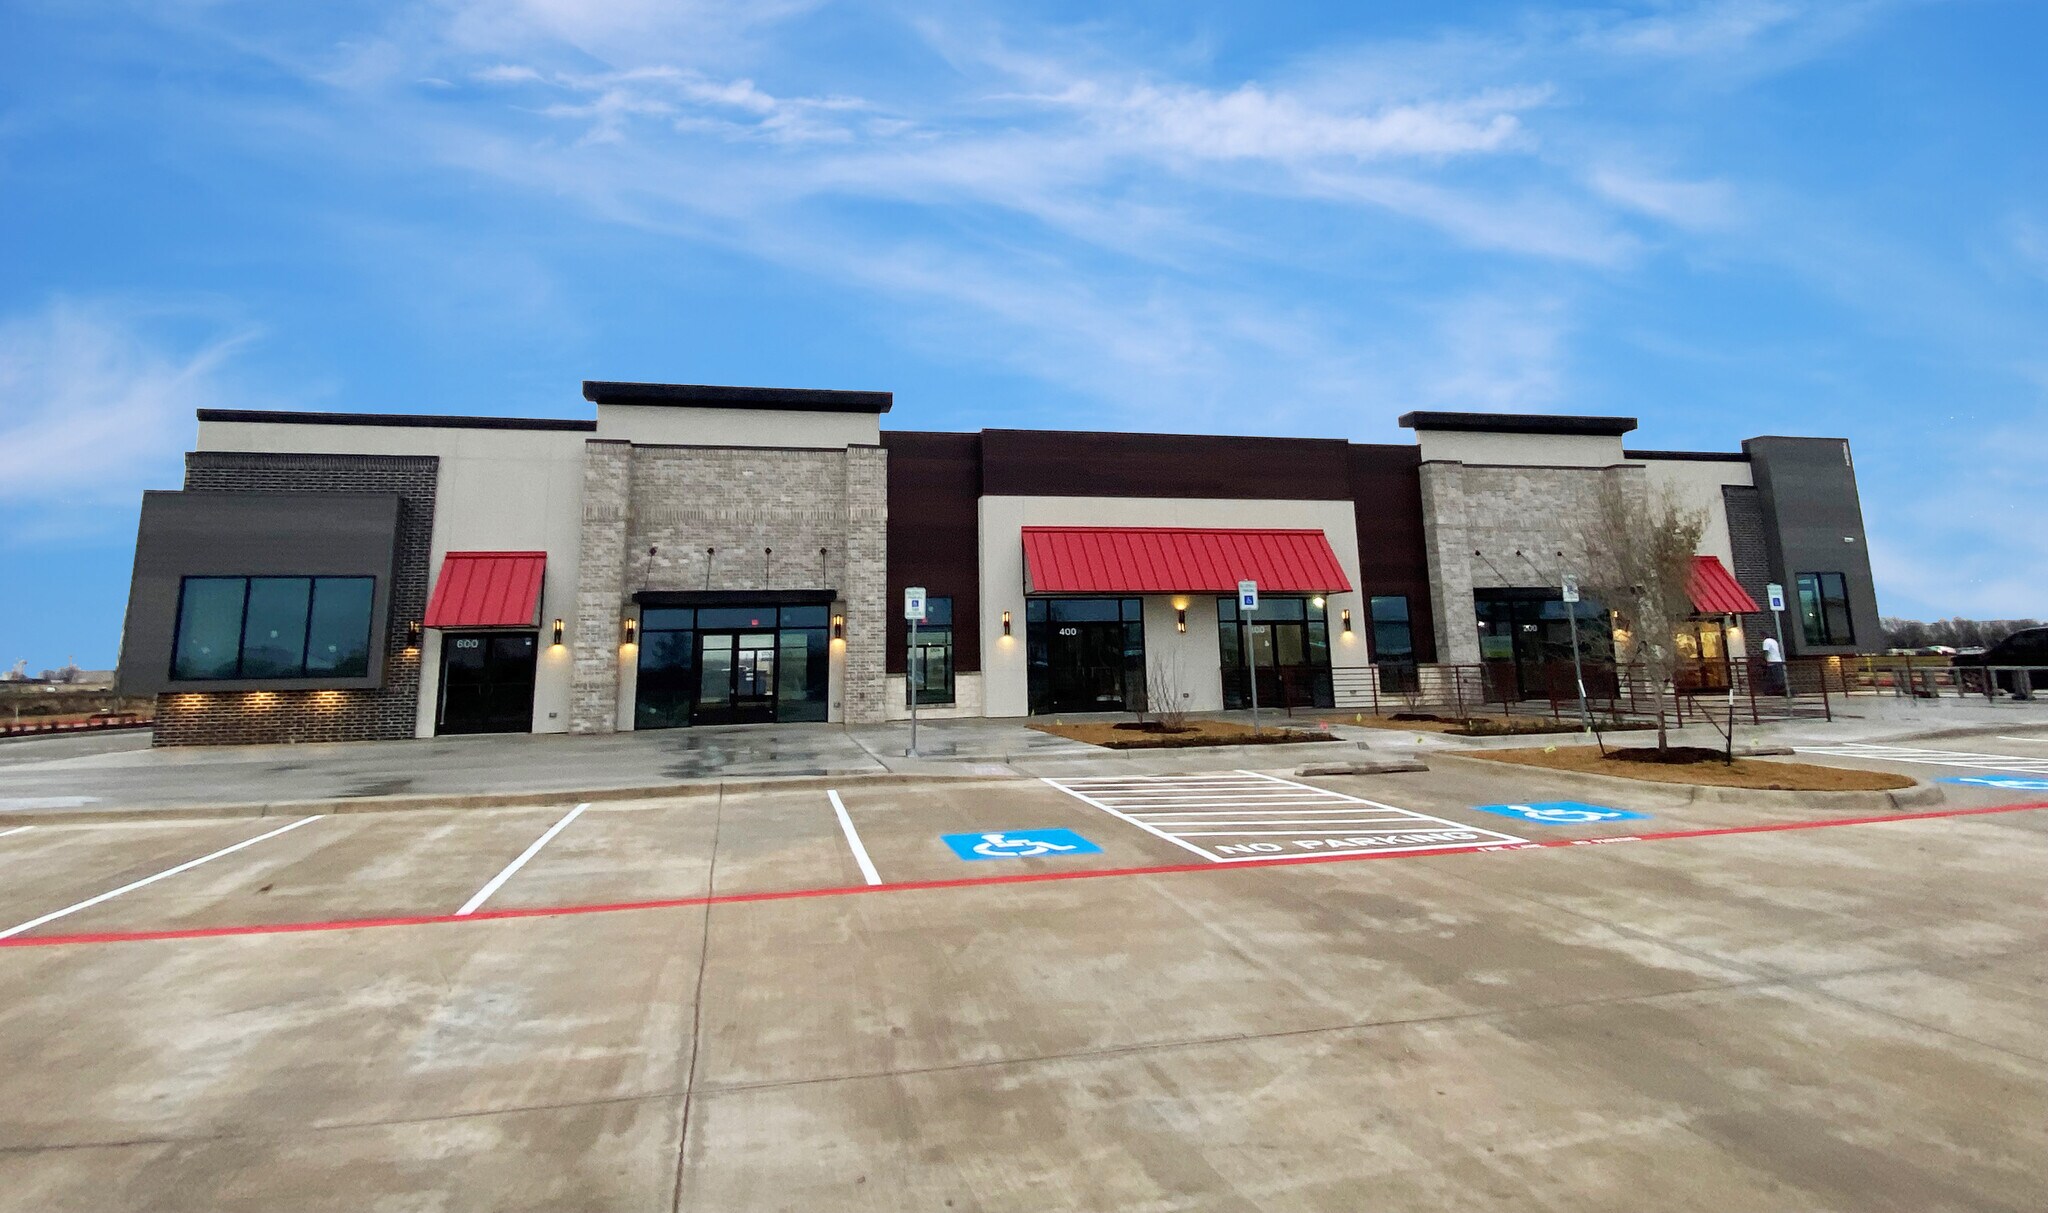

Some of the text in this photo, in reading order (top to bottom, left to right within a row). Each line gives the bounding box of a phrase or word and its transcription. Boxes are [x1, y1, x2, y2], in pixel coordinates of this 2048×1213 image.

[1059, 627, 1077, 636] 400
[456, 639, 479, 649] 600
[1215, 843, 1283, 855] NO
[1292, 831, 1478, 850] PARKING
